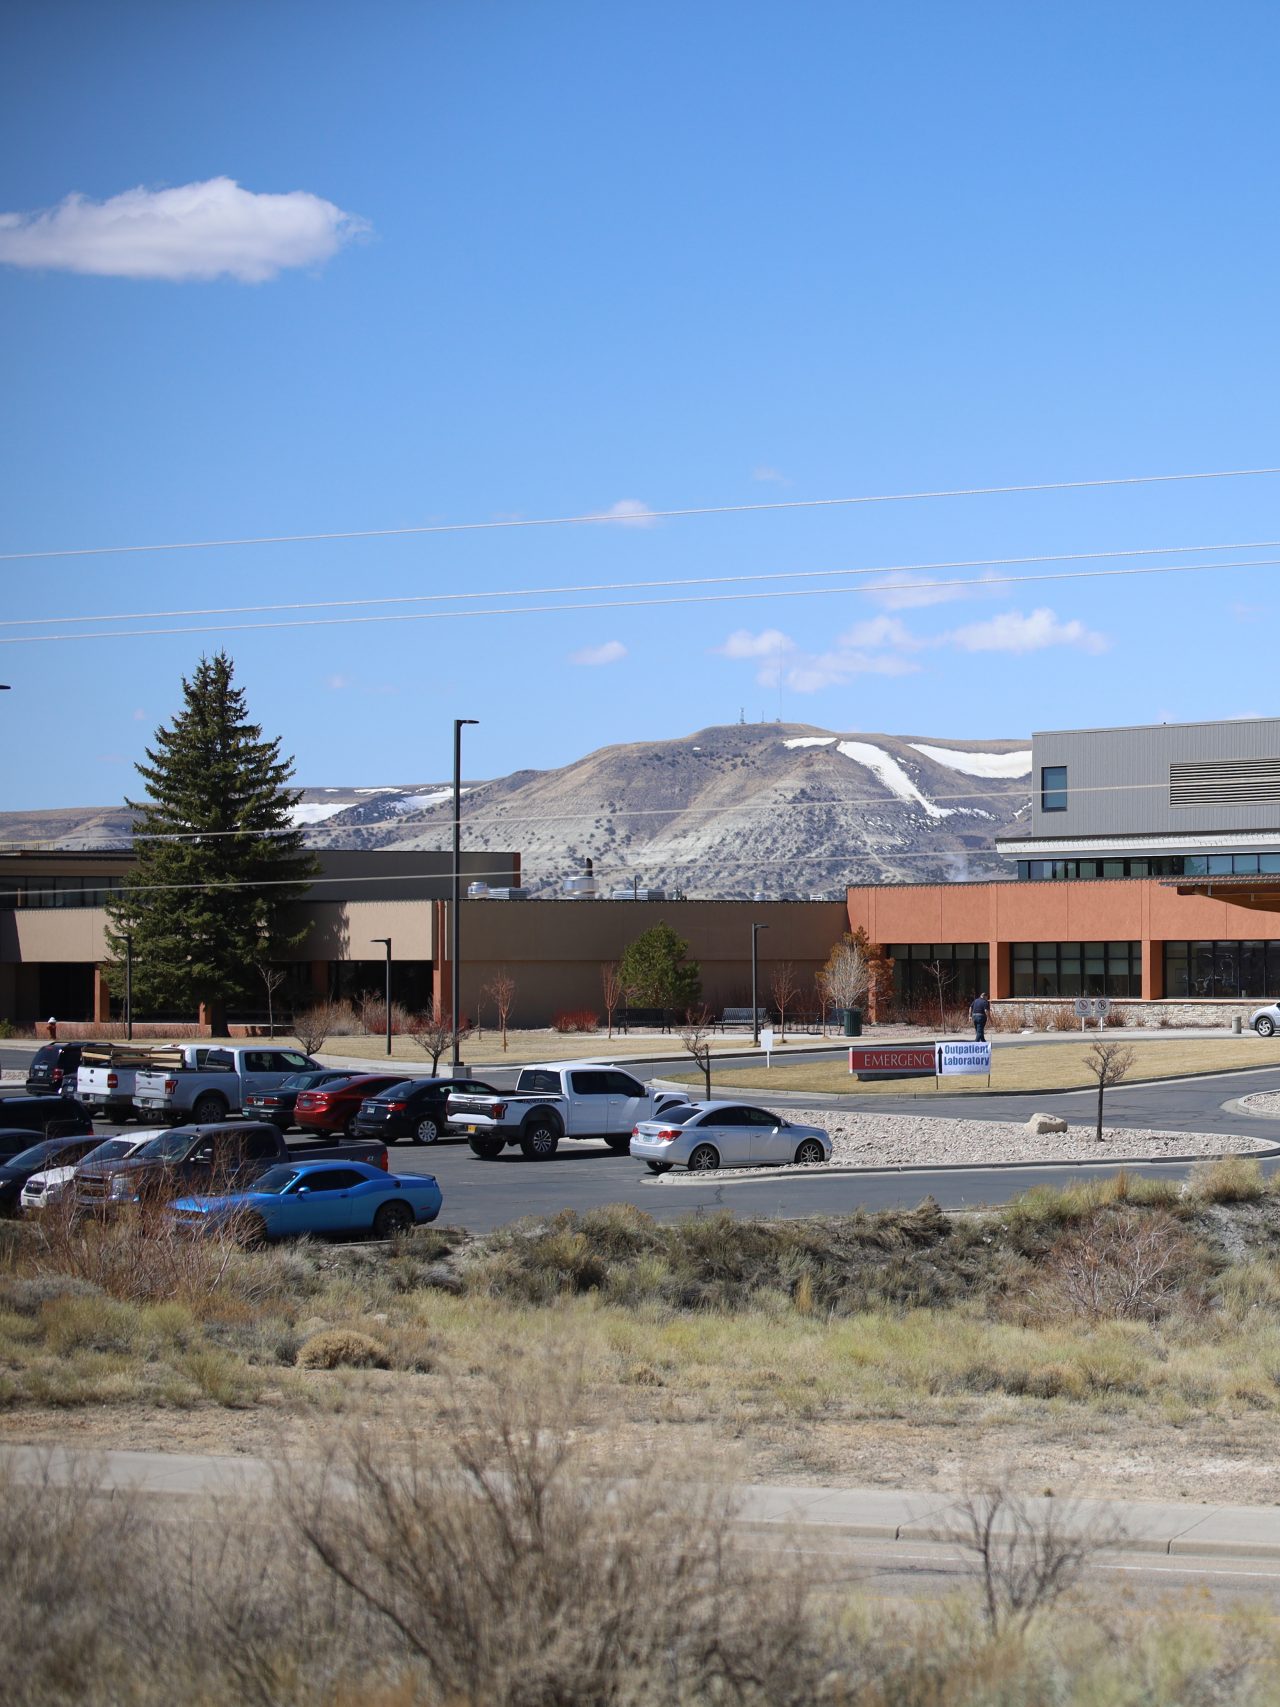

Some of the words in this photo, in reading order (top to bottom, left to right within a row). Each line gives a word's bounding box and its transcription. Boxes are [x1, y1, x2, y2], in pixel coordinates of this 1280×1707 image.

[944, 1044, 989, 1055] Outpatient
[864, 1053, 935, 1067] EMERGENCY
[944, 1056, 990, 1066] Laboratory
